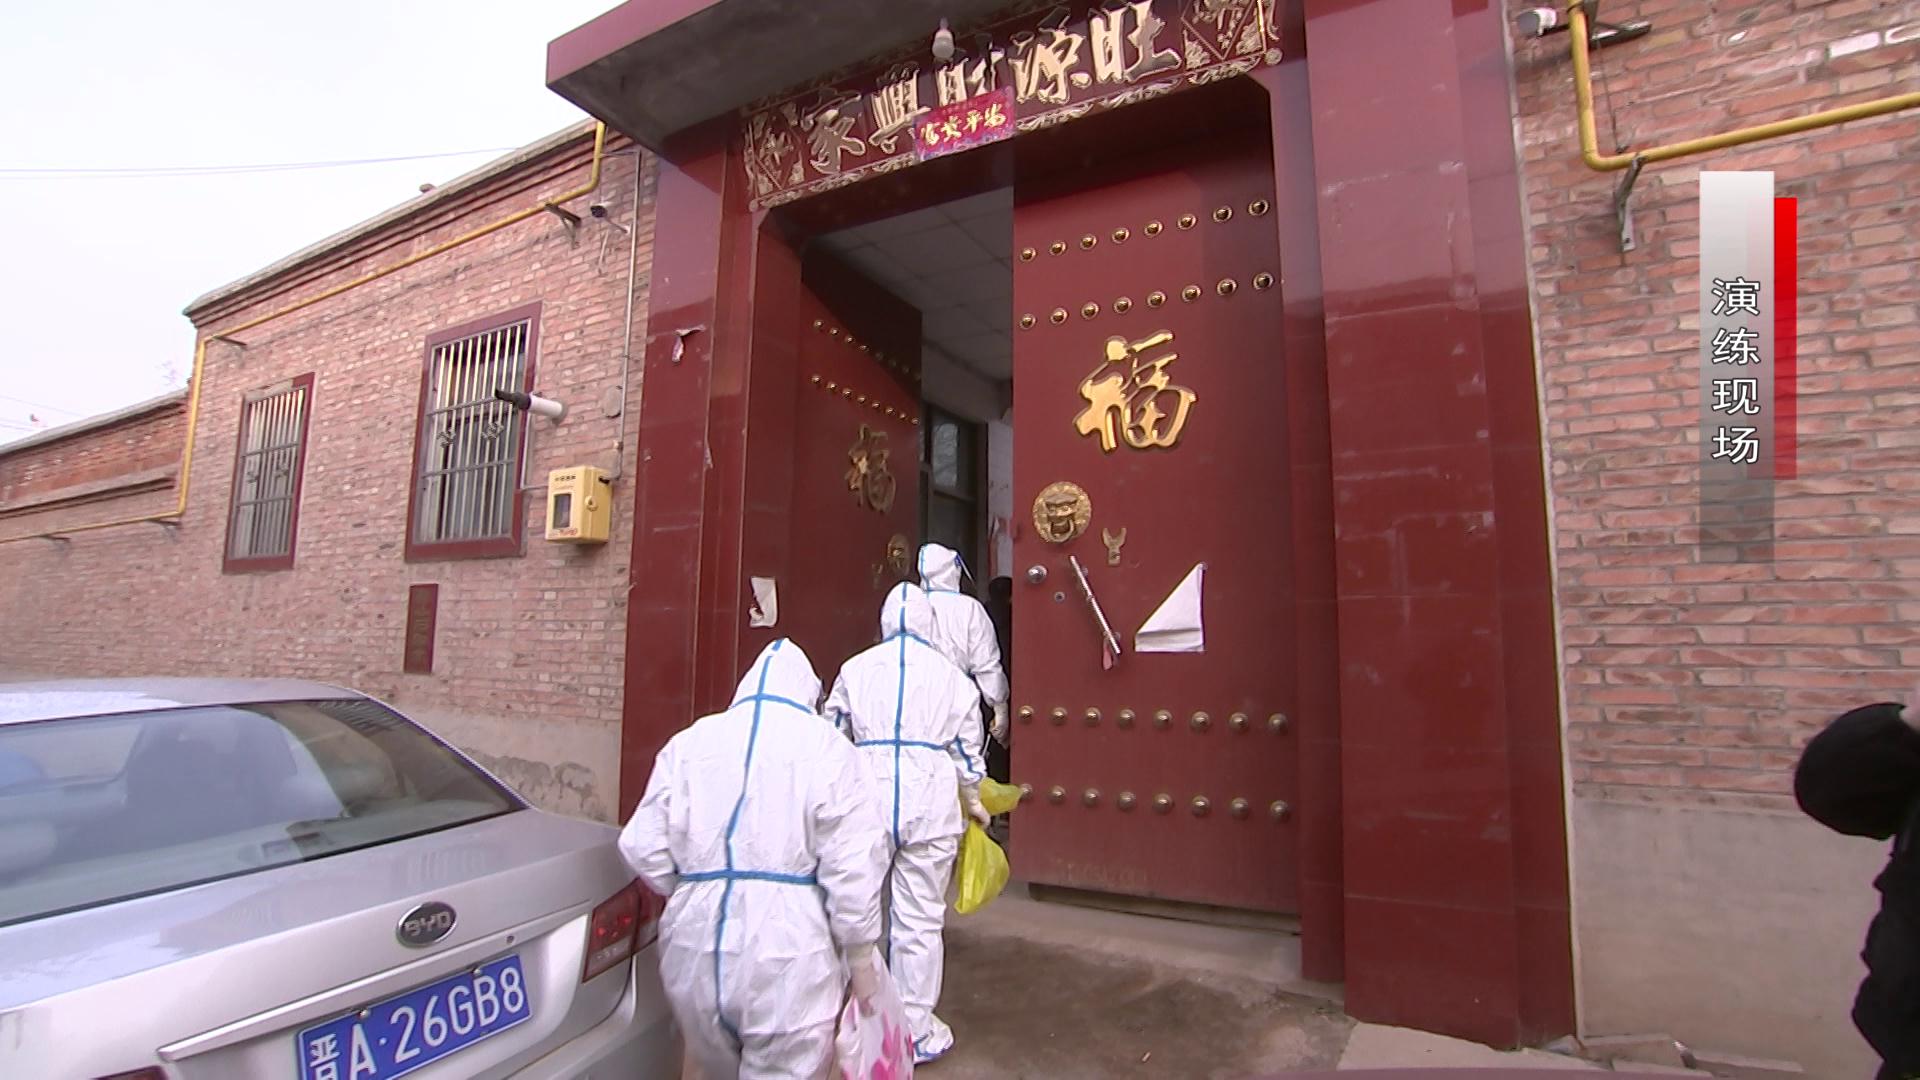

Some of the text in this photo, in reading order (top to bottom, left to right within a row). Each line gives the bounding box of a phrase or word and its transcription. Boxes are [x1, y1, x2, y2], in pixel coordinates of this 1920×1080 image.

[1073, 330, 1198, 455] 福
[845, 424, 897, 515] 福
[404, 910, 452, 937] BYD
